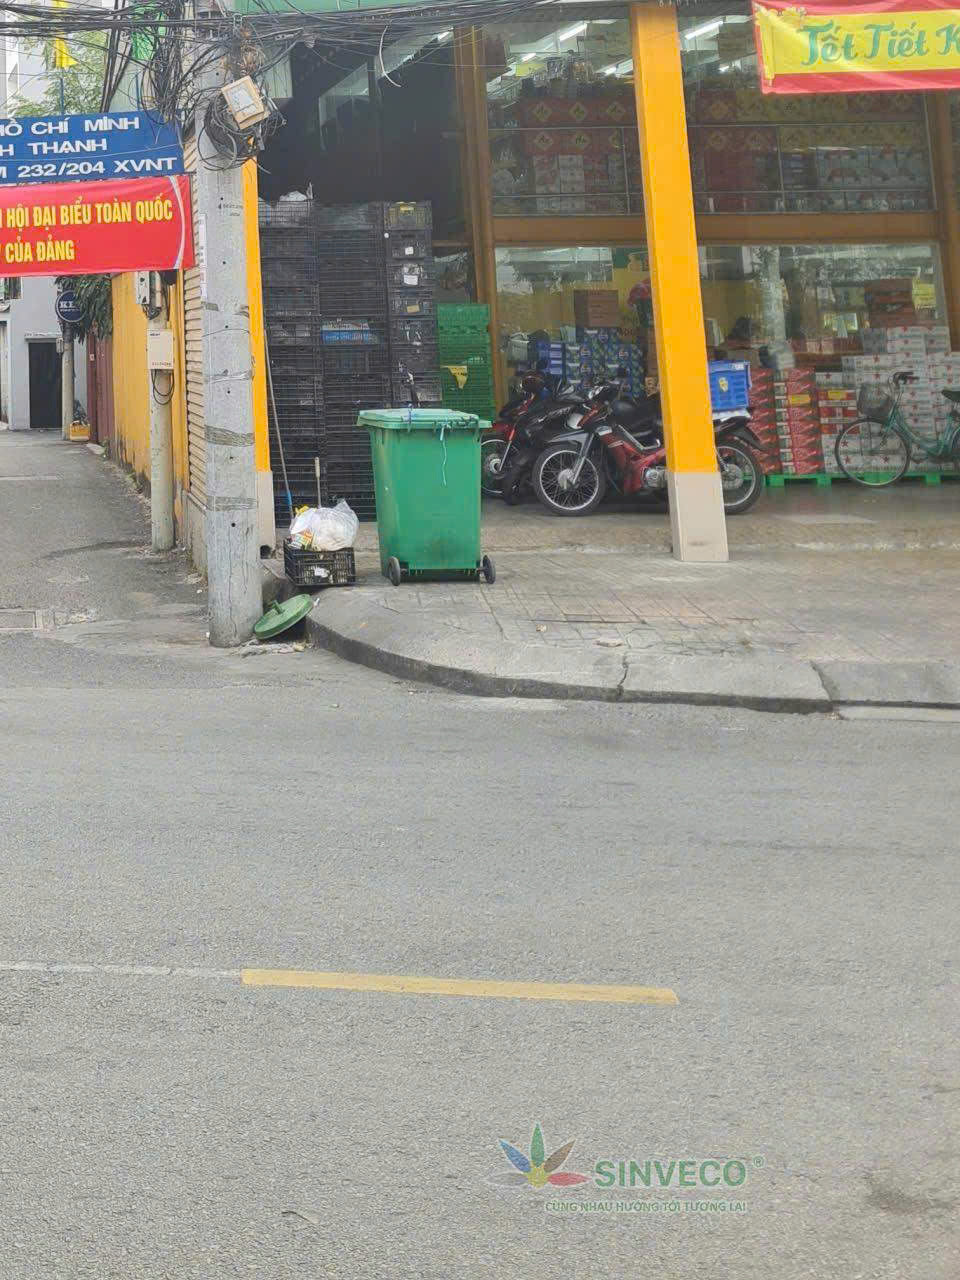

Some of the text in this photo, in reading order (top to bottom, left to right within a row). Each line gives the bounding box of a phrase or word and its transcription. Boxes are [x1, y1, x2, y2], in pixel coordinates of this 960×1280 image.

[797, 20, 858, 65] Tết
[864, 22, 929, 59] Tiết
[31, 117, 70, 135] CHÍ
[27, 138, 107, 156] THẠNH
[18, 160, 105, 178] 232/204
[114, 157, 177, 173] XVNT
[6, 203, 29, 232] HỘI
[33, 205, 56, 231] ĐẠI
[60, 195, 91, 225] BIỂU
[95, 198, 132, 224] TOÀN
[135, 193, 173, 223] QUỐC
[5, 235, 33, 263] CỦA
[36, 234, 75, 261] ĐẢNG
